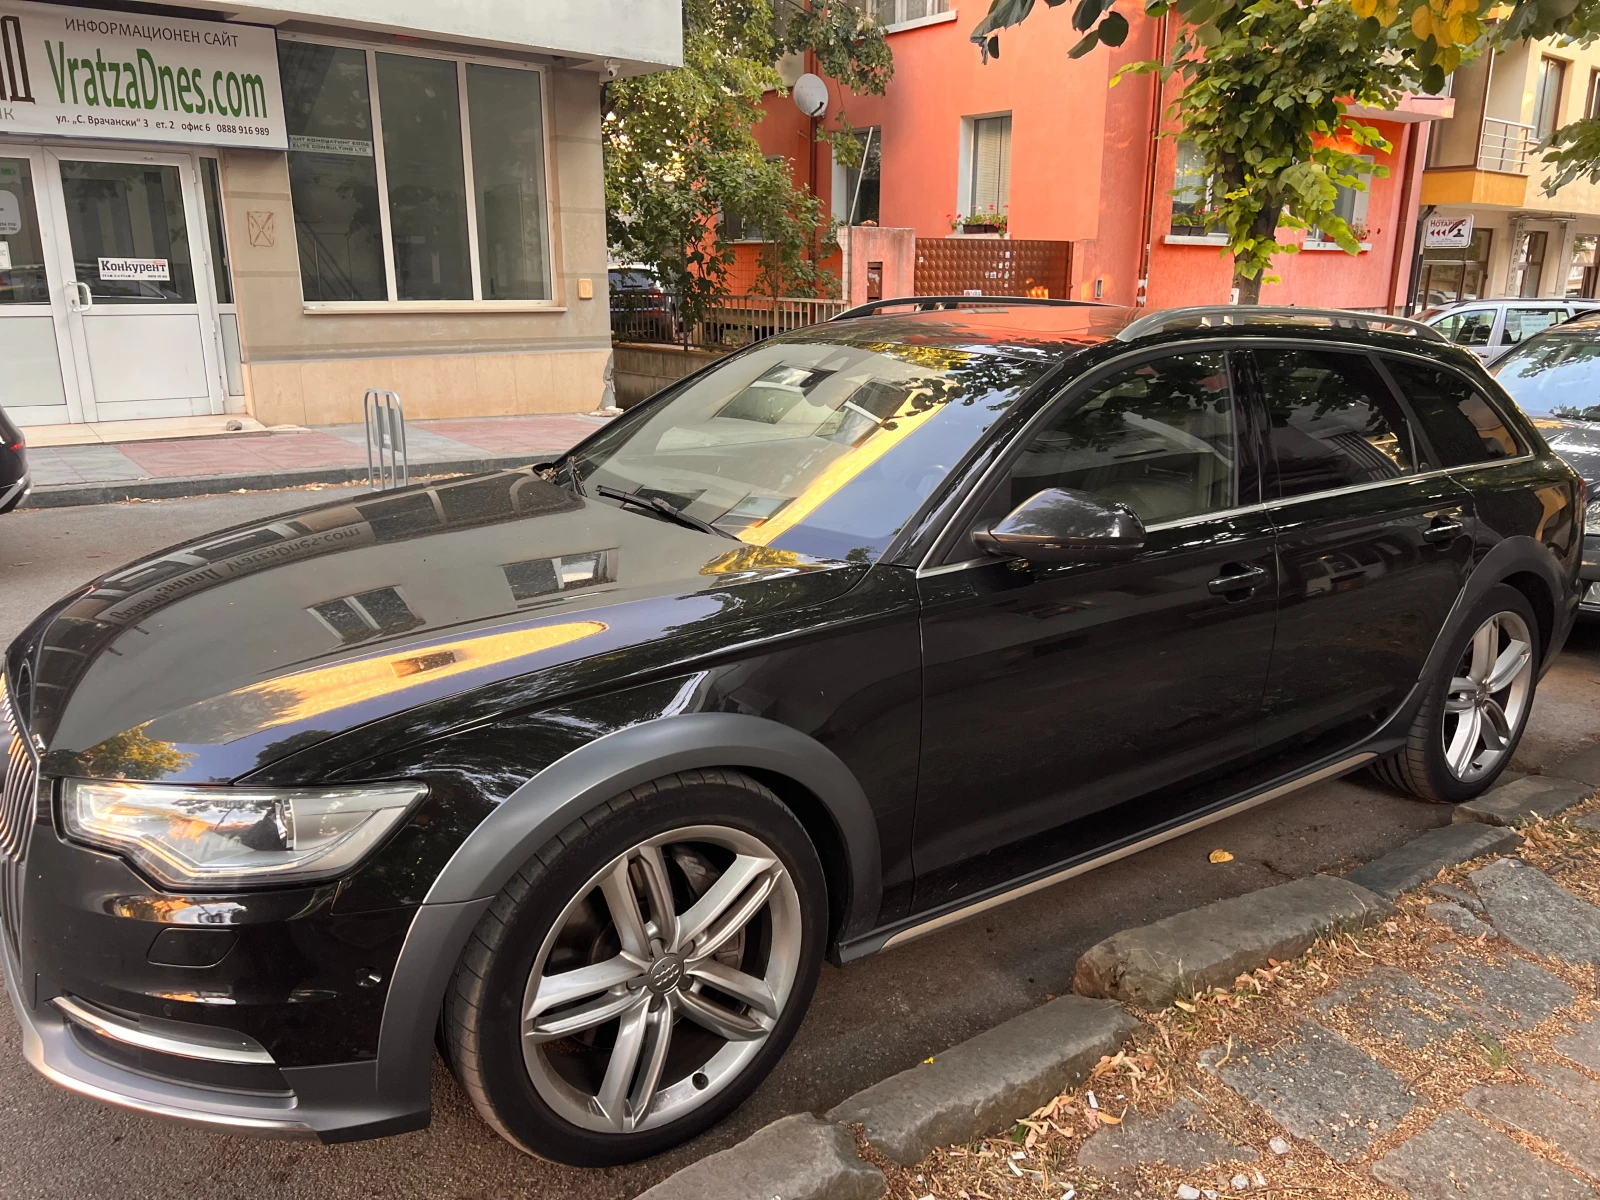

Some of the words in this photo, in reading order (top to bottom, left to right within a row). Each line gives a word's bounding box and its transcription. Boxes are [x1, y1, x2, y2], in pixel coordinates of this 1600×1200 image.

[64, 17, 200, 43] ИНФОРМАЦИОНЕН
[204, 31, 239, 48] САЙТ
[44, 40, 268, 119] VratzaDnes.com
[55, 115, 70, 125] ул.
[143, 118, 149, 128] 3
[155, 121, 168, 129] ет.
[169, 120, 175, 129] 2
[181, 122, 204, 132] офис
[205, 123, 211, 131] 6
[216, 123, 237, 134] 0888
[238, 125, 254, 135] 916
[255, 126, 270, 136] 989
[311, 144, 354, 152] CONSULTING
[101, 260, 167, 274] Конкурент
[1508, 222, 1524, 291] НОТАРИУС
